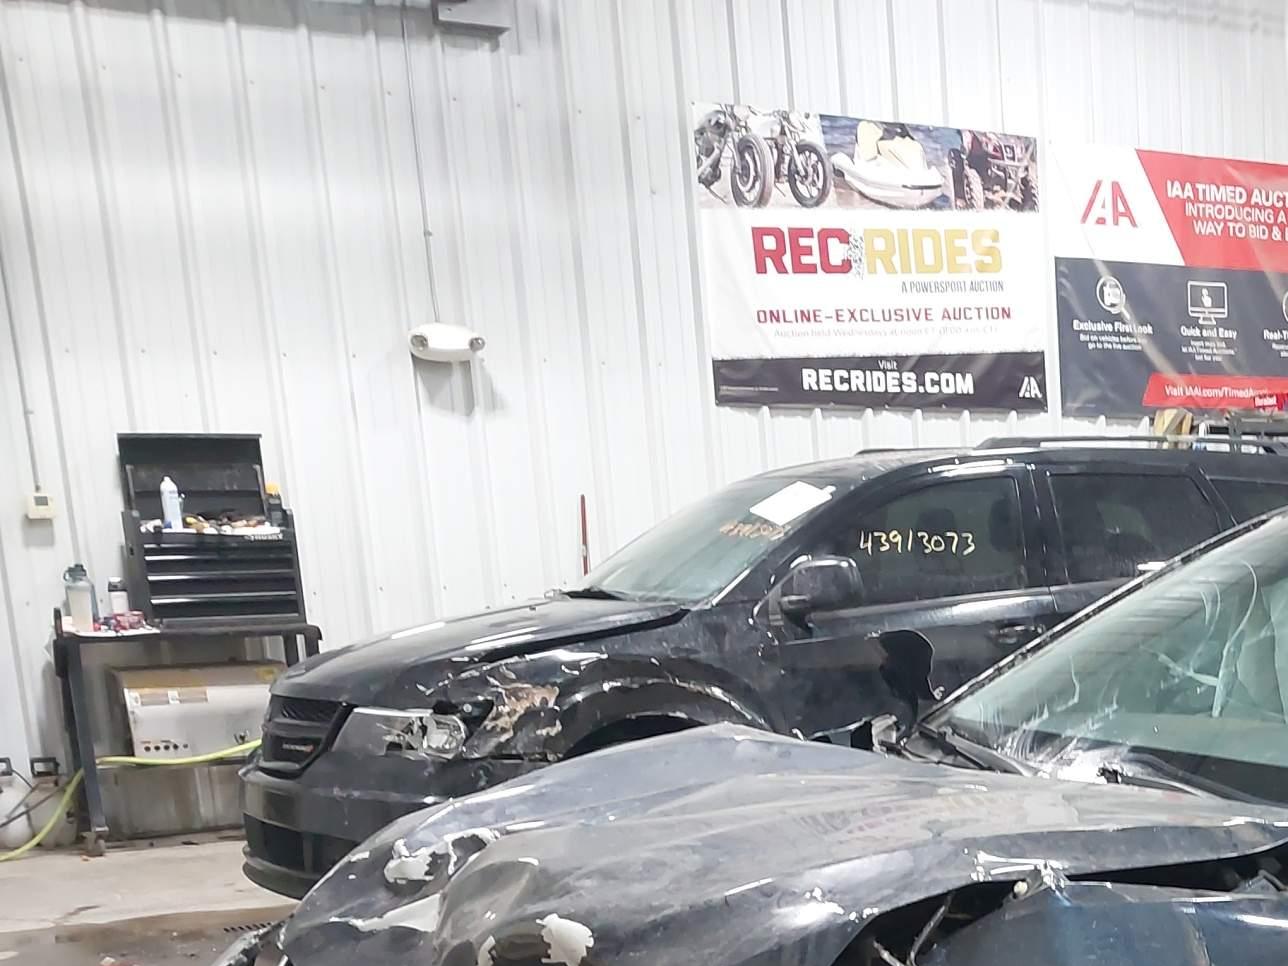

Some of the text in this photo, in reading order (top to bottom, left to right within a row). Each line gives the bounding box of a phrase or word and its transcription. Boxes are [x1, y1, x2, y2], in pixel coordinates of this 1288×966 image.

[1167, 180, 1194, 200] IAA
[1195, 183, 1247, 204] TIMED
[1185, 202, 1274, 223] INTRODUCING
[1277, 211, 1287, 225] A
[1193, 220, 1225, 236] WAY
[1227, 221, 1246, 238] TO
[1249, 224, 1269, 241] BID
[1272, 226, 1281, 241] &
[751, 227, 1003, 275] REC RIDES
[901, 280, 1004, 294] A POWERSPORT AUCTION
[757, 306, 1012, 324] ONLINE-EXCLUSIVE AUCTION
[1073, 320, 1113, 332] Exclusive
[1114, 321, 1133, 333] First
[1180, 325, 1237, 340] Quick and Easy
[878, 360, 897, 369] Visit
[802, 368, 974, 394] RECRIDES.COM
[1165, 385, 1183, 396] Visit
[860, 528, 975, 556] 43913073
